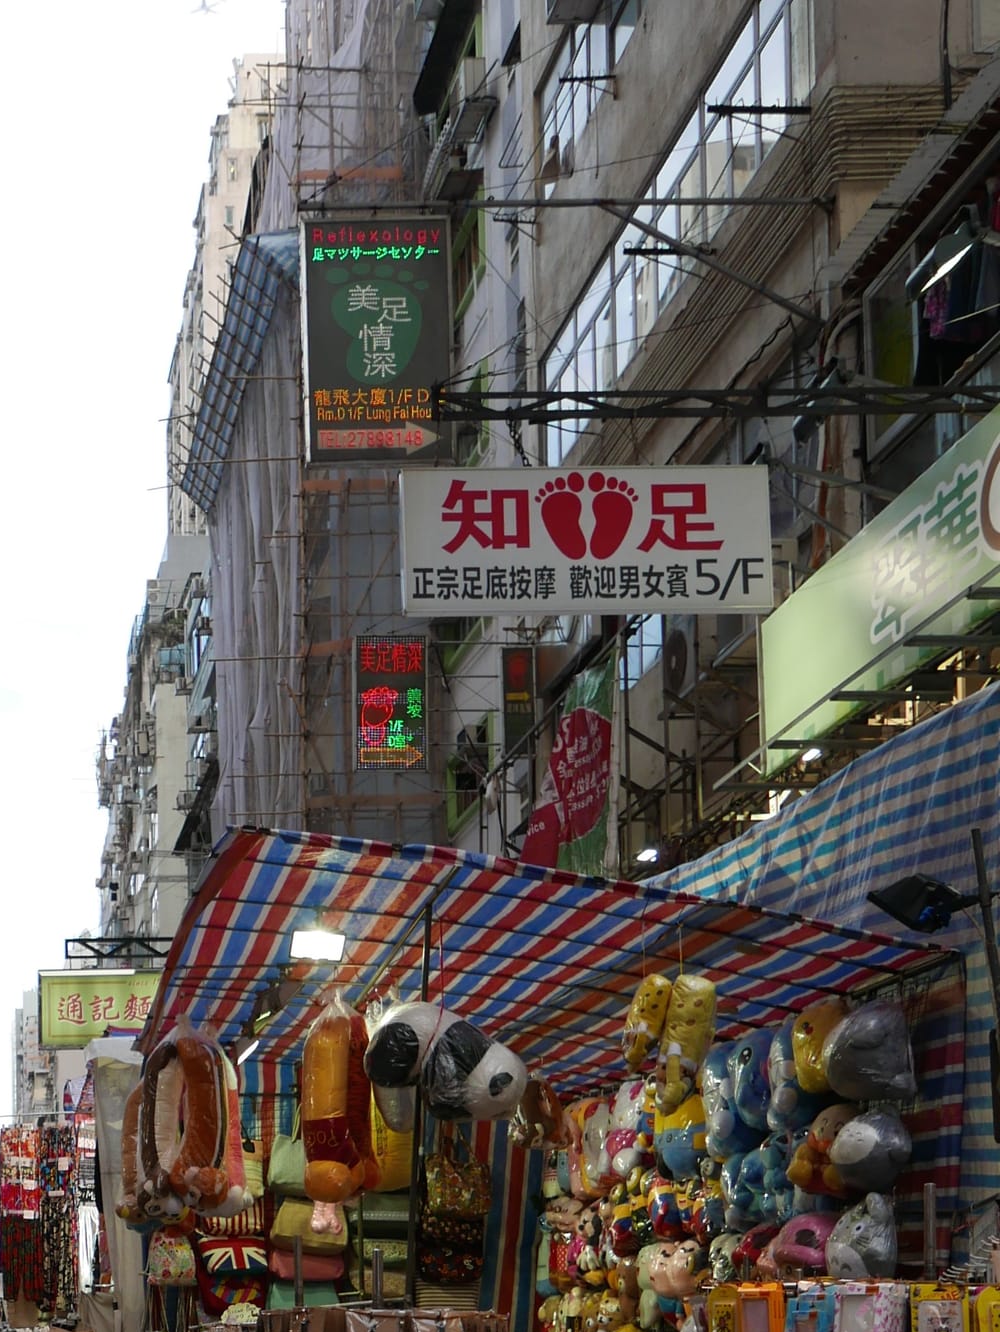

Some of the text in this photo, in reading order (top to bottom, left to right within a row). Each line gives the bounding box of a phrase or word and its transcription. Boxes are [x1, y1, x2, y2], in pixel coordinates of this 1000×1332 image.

[312, 228, 440, 243] Reflexology
[366, 406, 391, 422] Lung
[411, 404, 432, 419] Hou
[412, 557, 765, 602] 正宗足底按摩 歡迎男女賓 5/F
[360, 643, 423, 672] 美足情深
[526, 819, 546, 838] vice
[57, 993, 152, 1025] 通記麵
